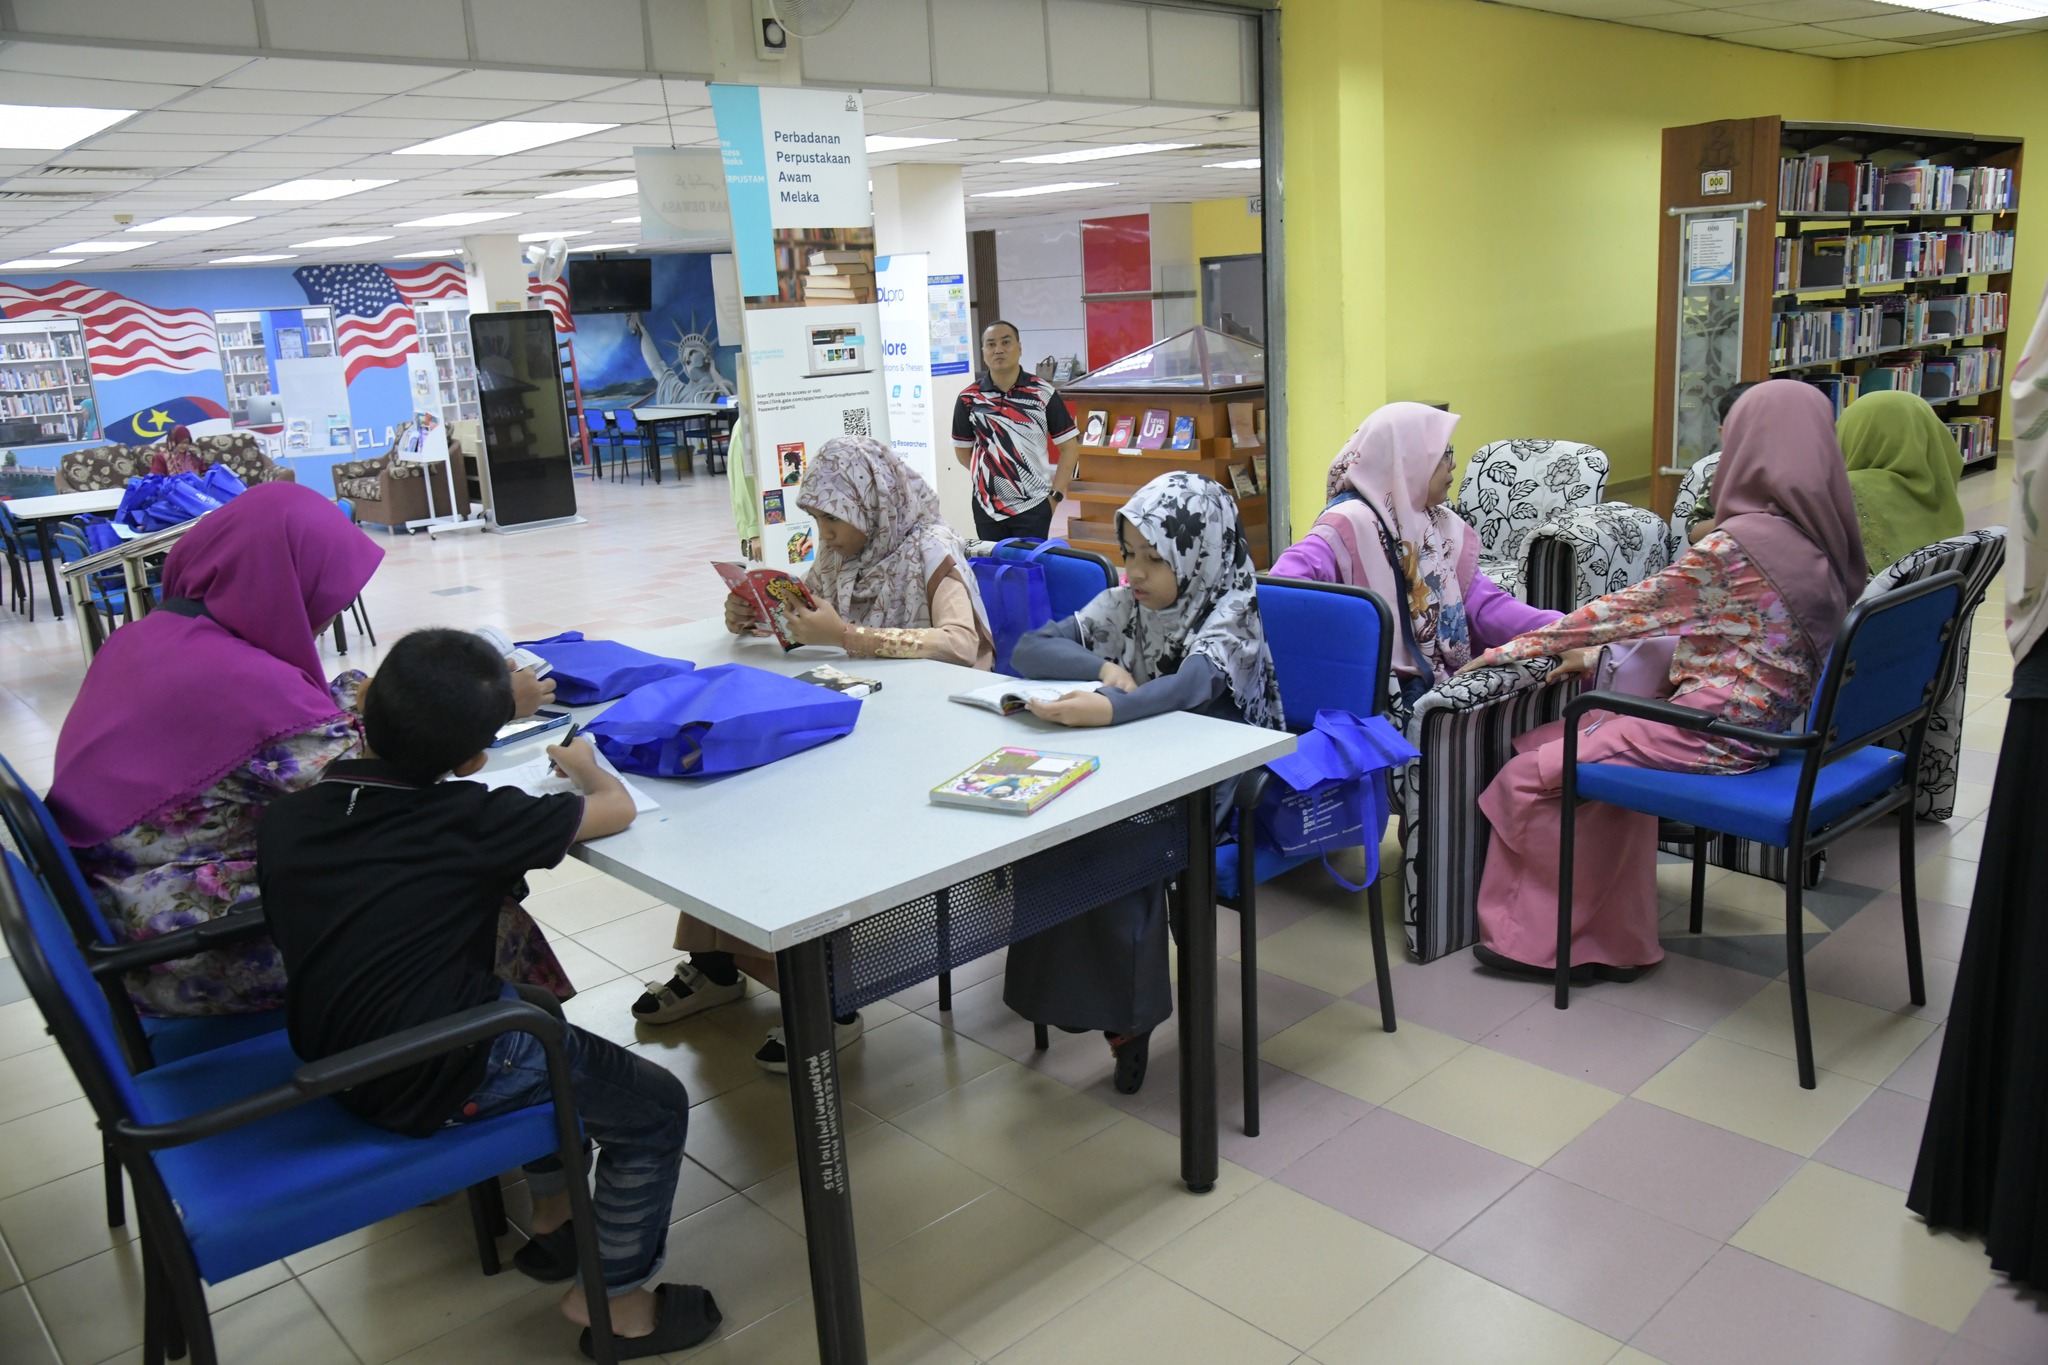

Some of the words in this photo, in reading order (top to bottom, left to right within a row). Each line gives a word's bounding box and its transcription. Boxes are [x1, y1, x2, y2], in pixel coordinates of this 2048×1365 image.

[774, 131, 841, 144] Perbadanan
[776, 151, 851, 166] Perpustakaan
[778, 171, 812, 183] Awam
[1709, 177, 1724, 187] 000
[780, 190, 820, 203] Melaka
[1143, 411, 1165, 439] UP
[1150, 417, 1165, 425] LEVEL
[897, 439, 927, 448] Researchers
[819, 1049, 831, 1078] HAK
